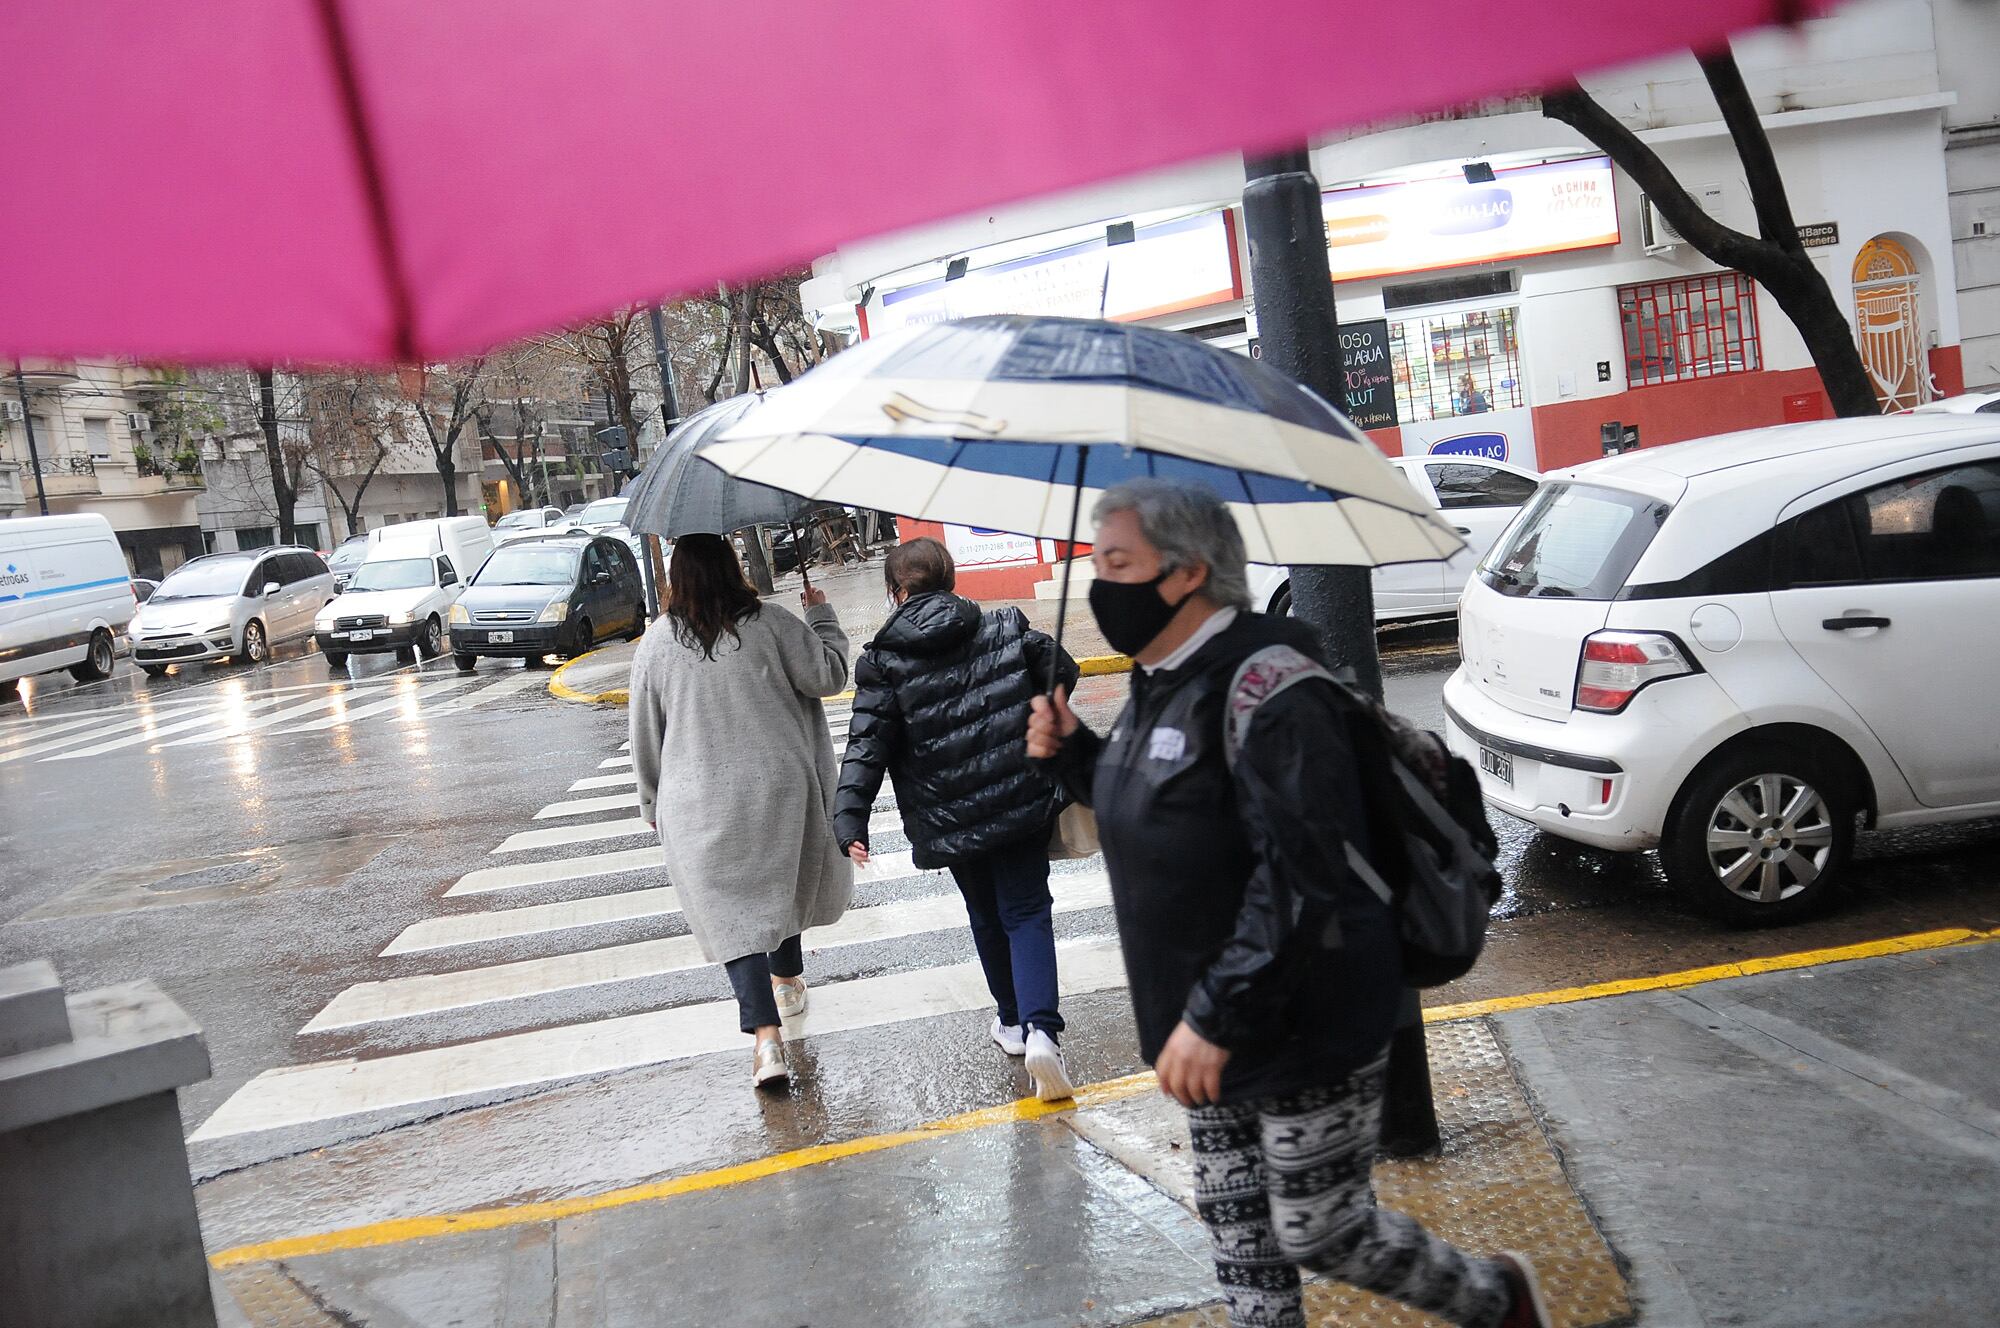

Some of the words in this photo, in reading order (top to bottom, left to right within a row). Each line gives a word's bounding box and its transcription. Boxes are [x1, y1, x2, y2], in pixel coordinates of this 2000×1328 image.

[1566, 180, 1596, 194] CHINA
[1806, 227, 1834, 237] Barco
[1354, 346, 1384, 366] AGUA
[1497, 757, 1511, 782] 287
